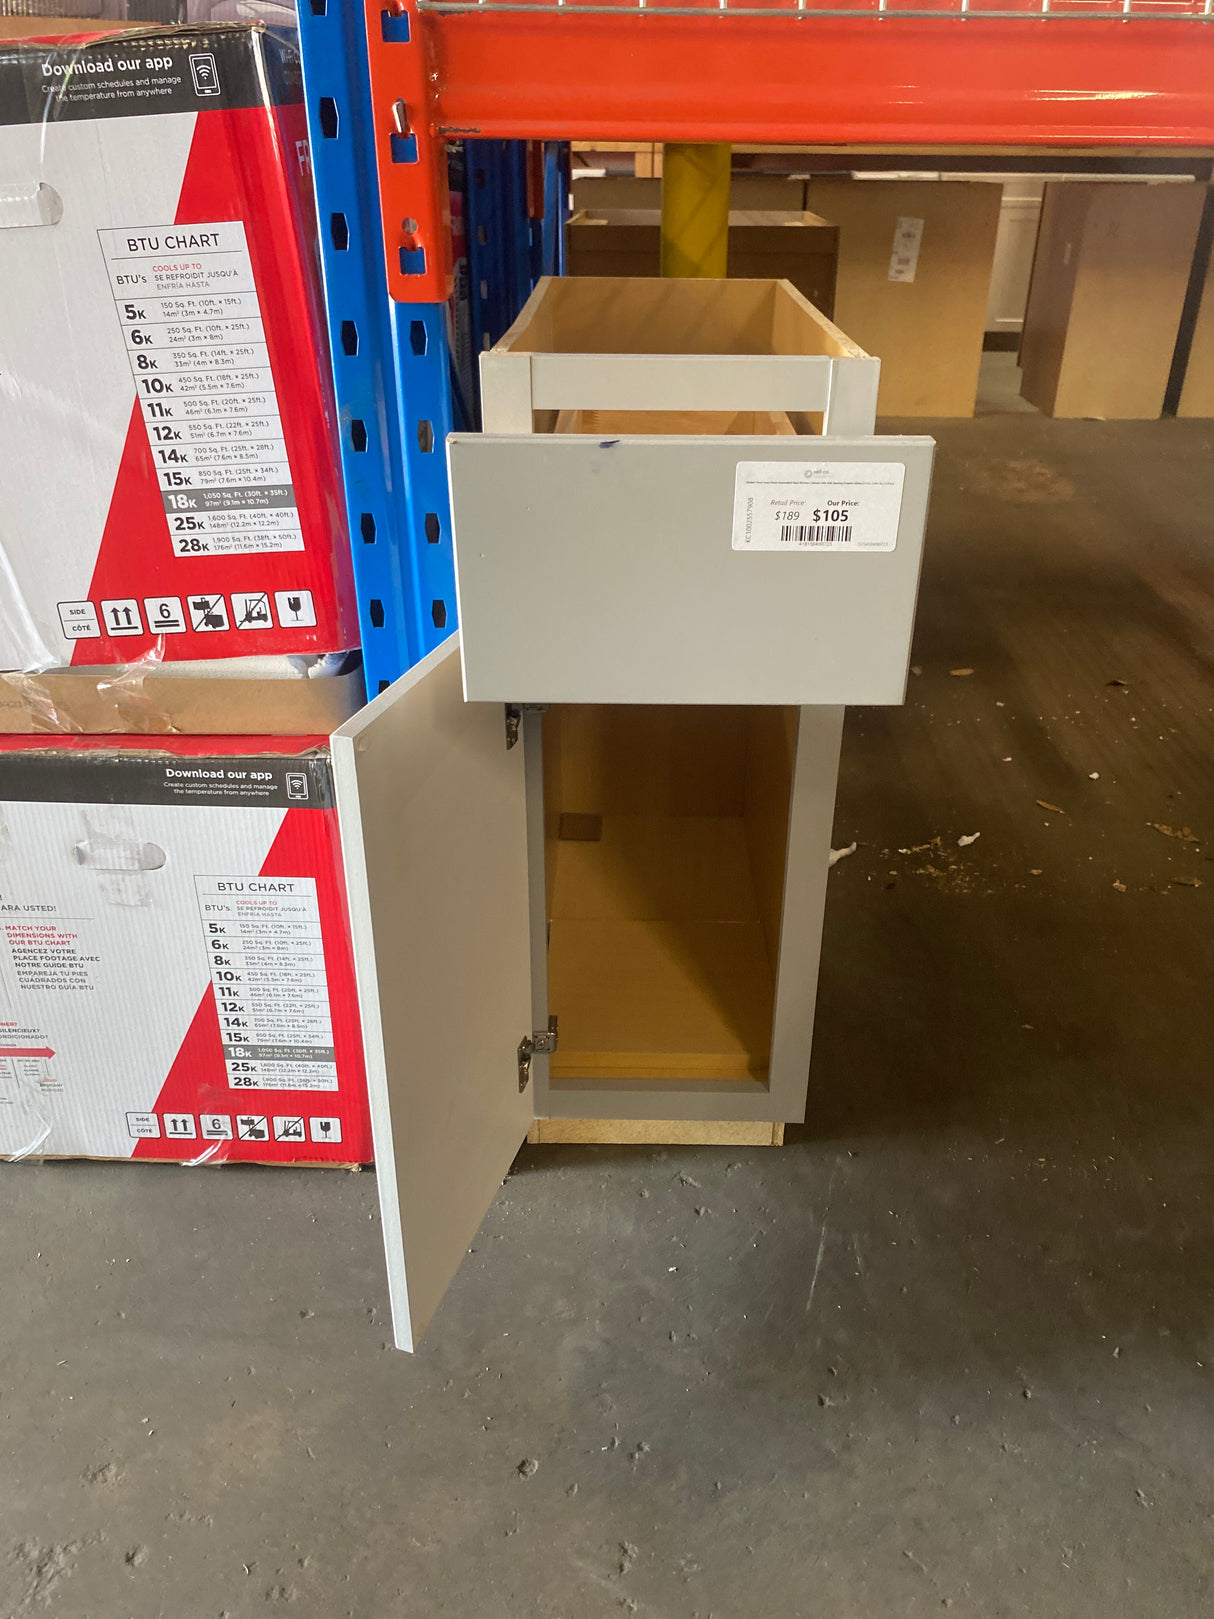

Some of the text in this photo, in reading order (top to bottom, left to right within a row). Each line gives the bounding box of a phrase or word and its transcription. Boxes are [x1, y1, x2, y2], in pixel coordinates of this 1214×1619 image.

[42, 57, 172, 76] Download our app
[68, 82, 95, 91] custom
[98, 79, 134, 89] schedules
[136, 78, 149, 86] and
[152, 76, 182, 84] manage
[70, 92, 115, 101] temperature
[117, 89, 135, 98] from
[136, 88, 172, 97] anywhere
[127, 233, 219, 251] BTU CHART
[116, 274, 147, 284] BTU's
[166, 272, 204, 281] REFROIDIT
[124, 304, 146, 319] 5K
[131, 329, 153, 344] 6K
[137, 355, 158, 369] 8K
[142, 378, 174, 393] 10K
[148, 403, 173, 417] 11K
[153, 426, 182, 441] 12K
[158, 450, 188, 464] 14K
[164, 472, 192, 486] 15K
[168, 494, 197, 509] 18K
[775, 510, 800, 520] $189
[813, 508, 848, 522] $105
[174, 517, 205, 530] 25K
[179, 539, 210, 552] 28K
[160, 603, 170, 618] 6
[166, 769, 224, 778] Download
[250, 772, 272, 780] app
[218, 883, 294, 892] BTU CHART
[209, 923, 225, 933] 5K
[212, 940, 229, 950] 6K
[214, 956, 231, 965] 8K
[216, 972, 242, 981] 10K
[219, 987, 239, 997] 11K
[222, 1003, 245, 1012] 12K
[224, 1018, 248, 1027] 14K
[226, 1033, 250, 1042] 15K
[228, 1048, 252, 1057] 18K
[232, 1063, 257, 1072] 25K
[234, 1077, 259, 1086] 28K
[212, 1119, 221, 1129] 6
